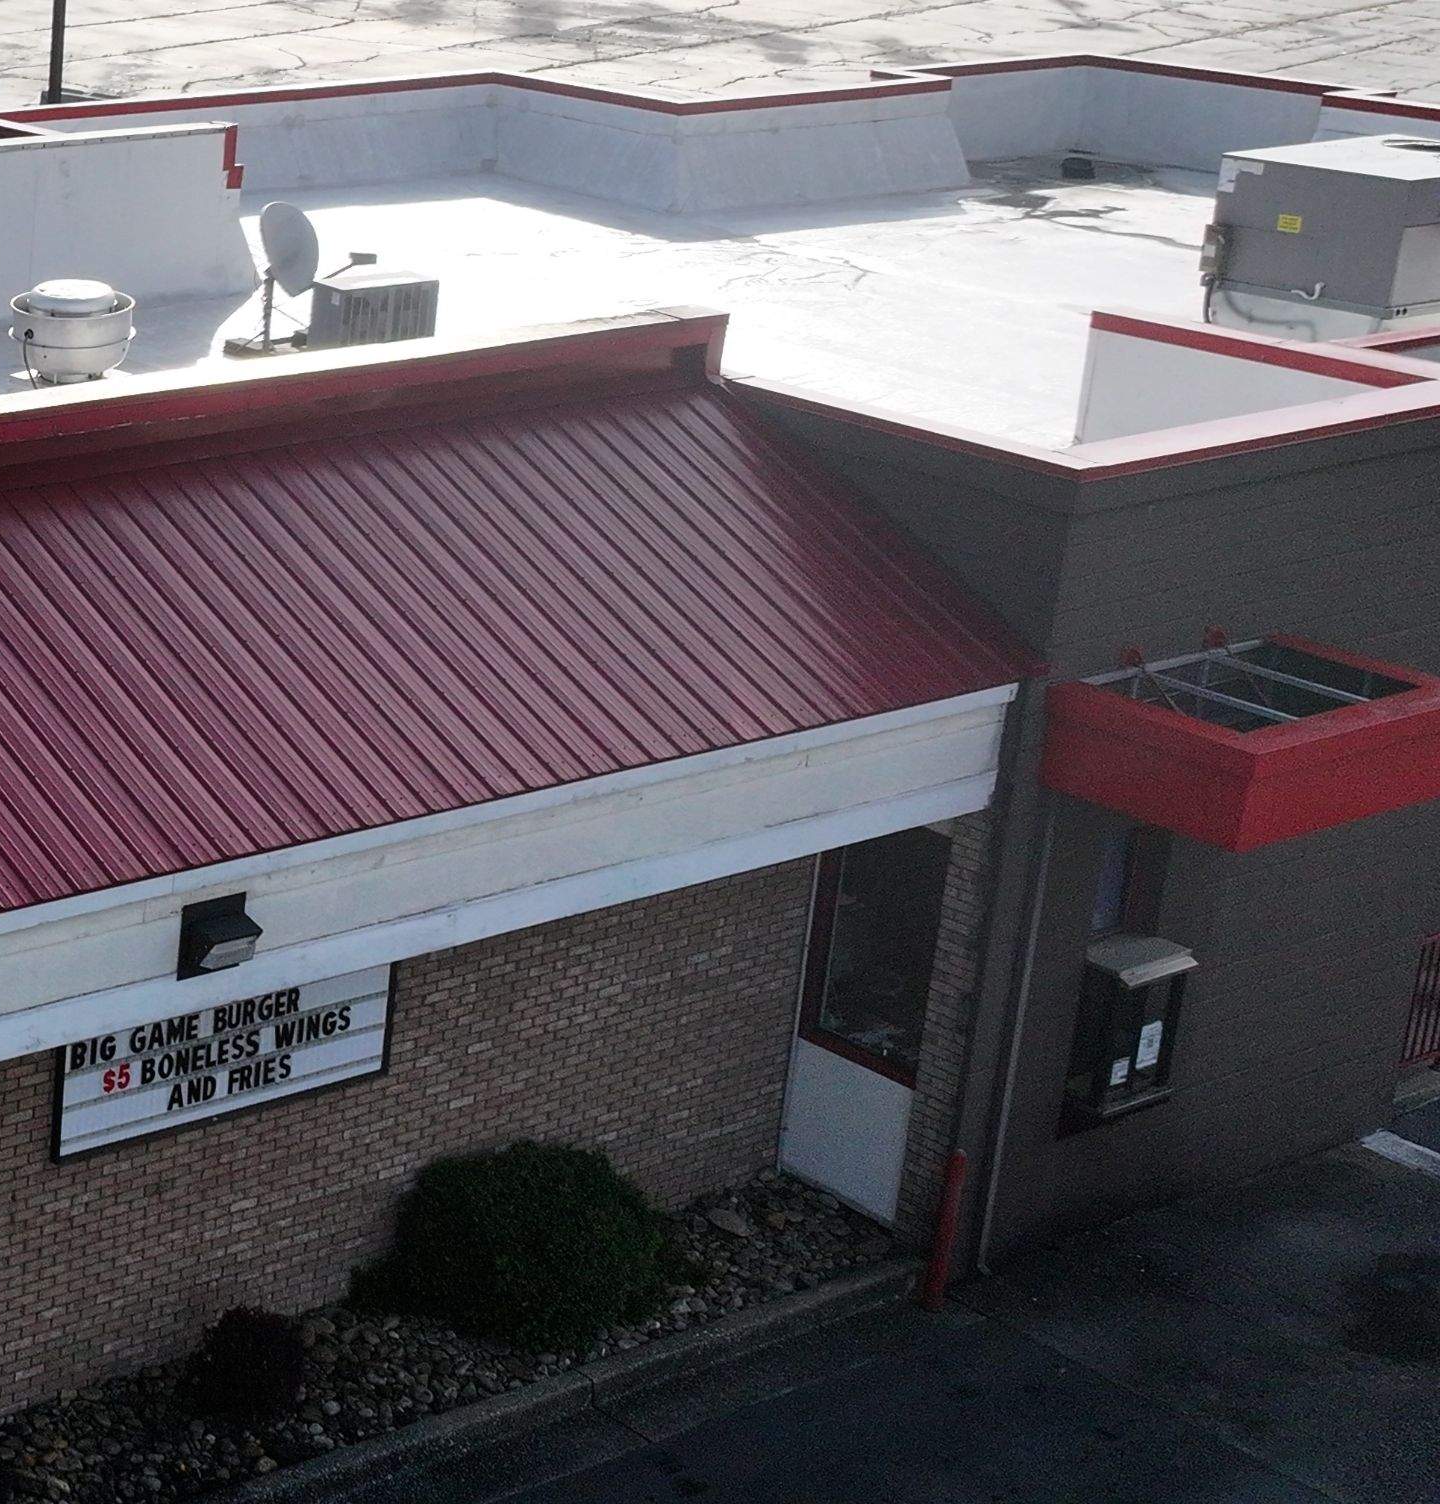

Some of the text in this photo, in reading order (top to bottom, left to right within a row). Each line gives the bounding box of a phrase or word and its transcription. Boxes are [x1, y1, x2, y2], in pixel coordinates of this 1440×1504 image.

[70, 987, 300, 1070] BIG GAME BURGER
[103, 1005, 351, 1093] $5 BONELESS WINGS
[167, 1054, 291, 1111] AND FRIES
